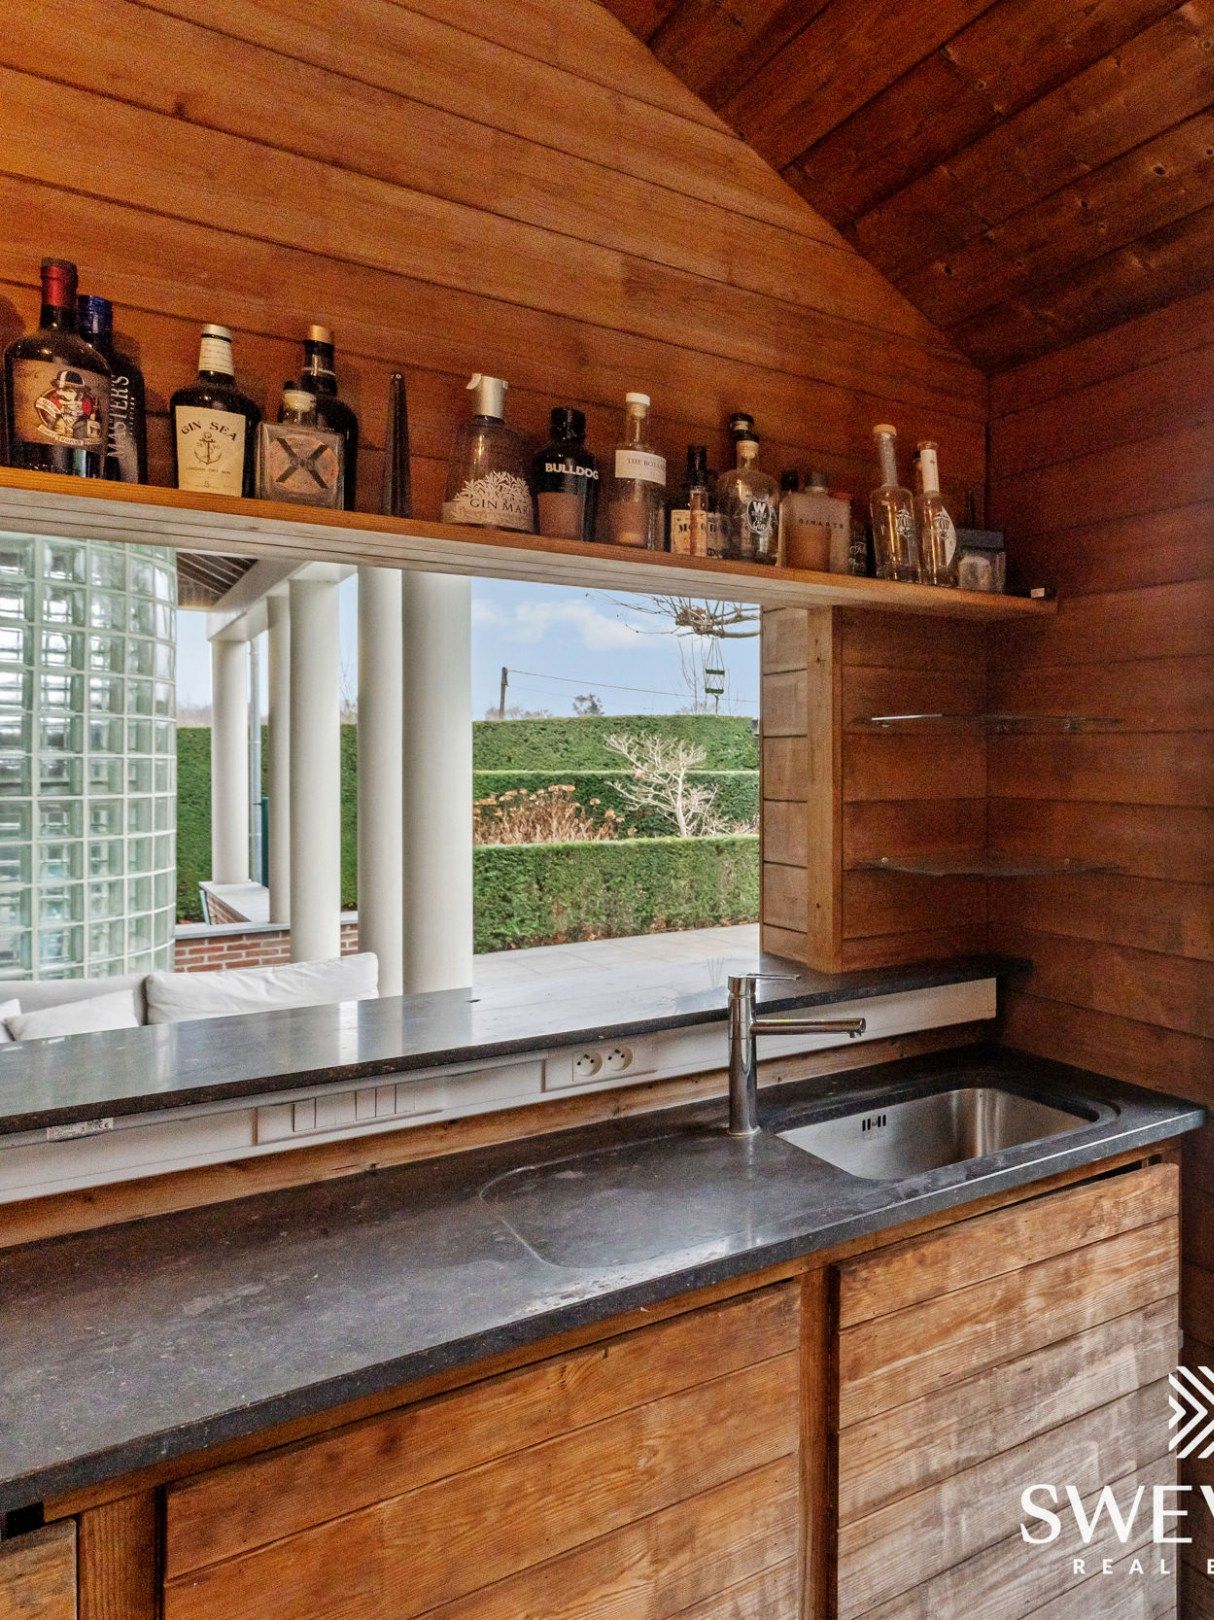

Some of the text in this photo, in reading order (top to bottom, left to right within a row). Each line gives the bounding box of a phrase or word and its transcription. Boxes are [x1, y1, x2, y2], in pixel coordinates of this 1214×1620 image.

[181, 421, 237, 441] GIN SEA
[545, 462, 600, 480] BULLDOG
[469, 497, 498, 510] GIN
